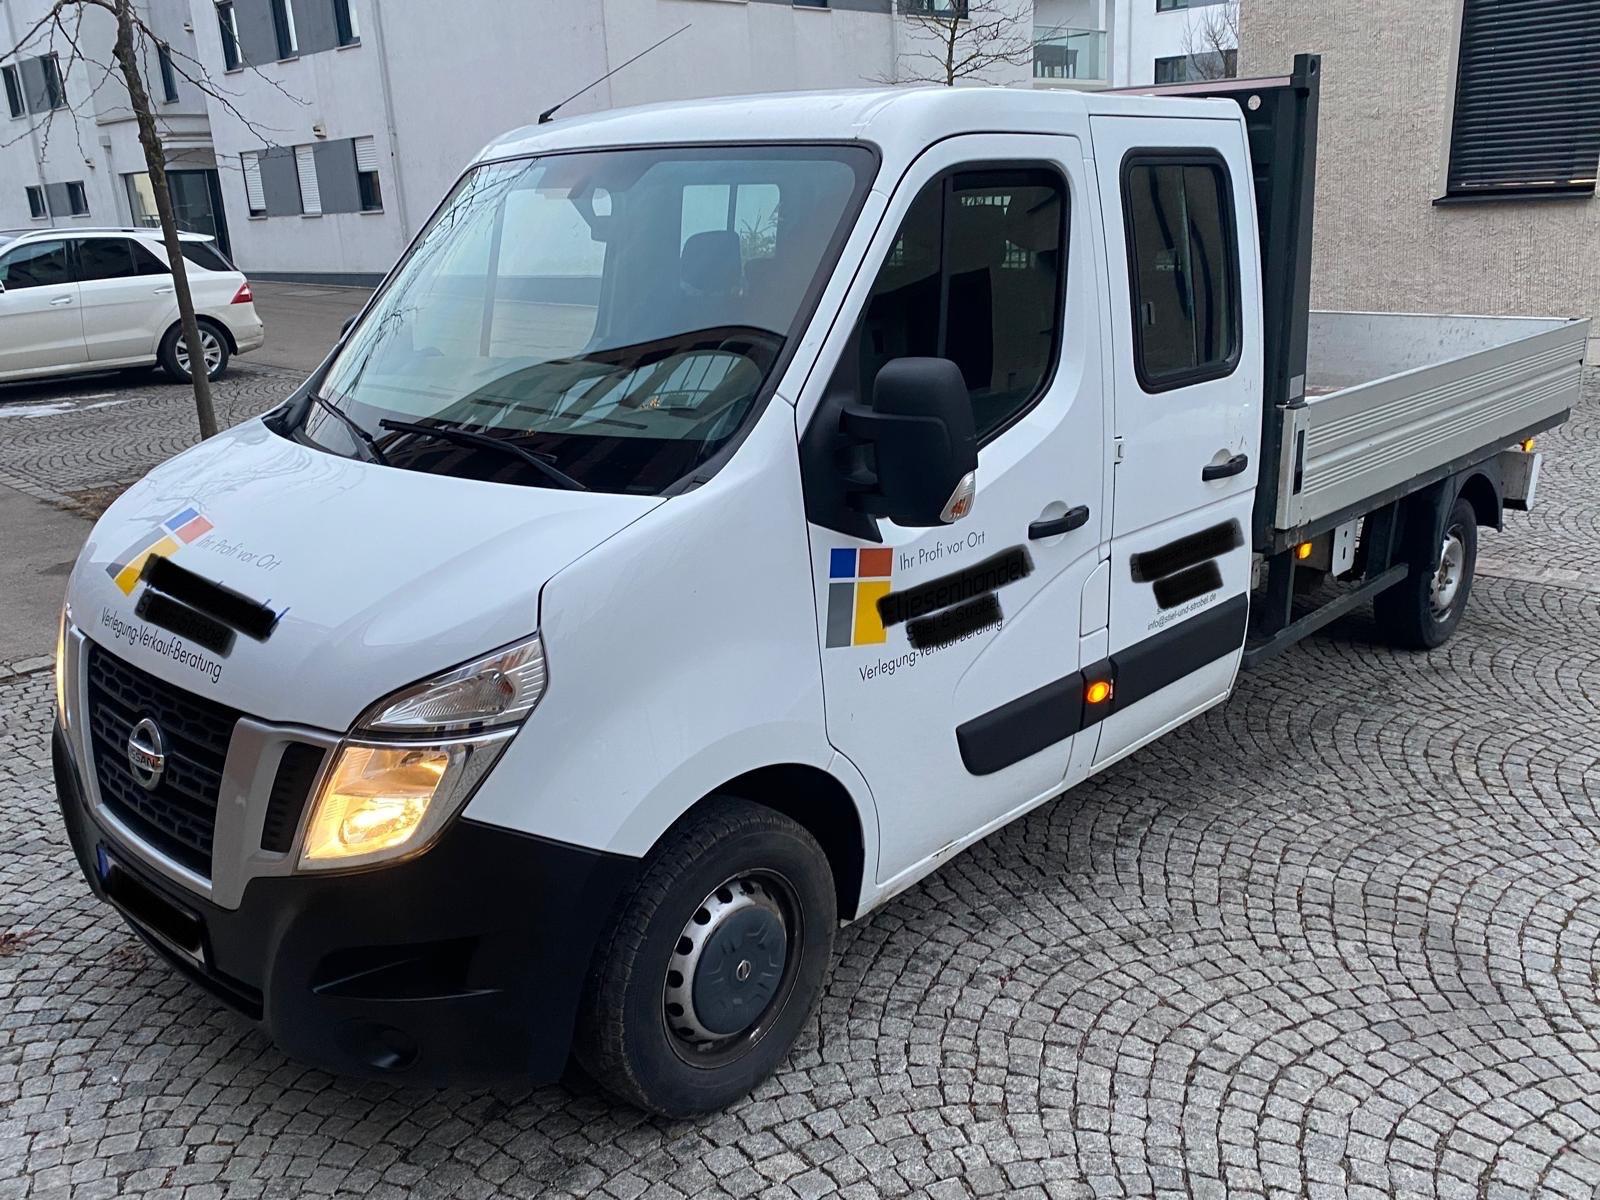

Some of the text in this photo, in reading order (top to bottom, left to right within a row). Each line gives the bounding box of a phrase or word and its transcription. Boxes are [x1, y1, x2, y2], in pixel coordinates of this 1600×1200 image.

[196, 534, 282, 571] Ihr Profi vor Ort
[899, 531, 985, 571] Ihr Profi vor Ort
[101, 607, 222, 683] Verlegung-Verkauf-Beratung
